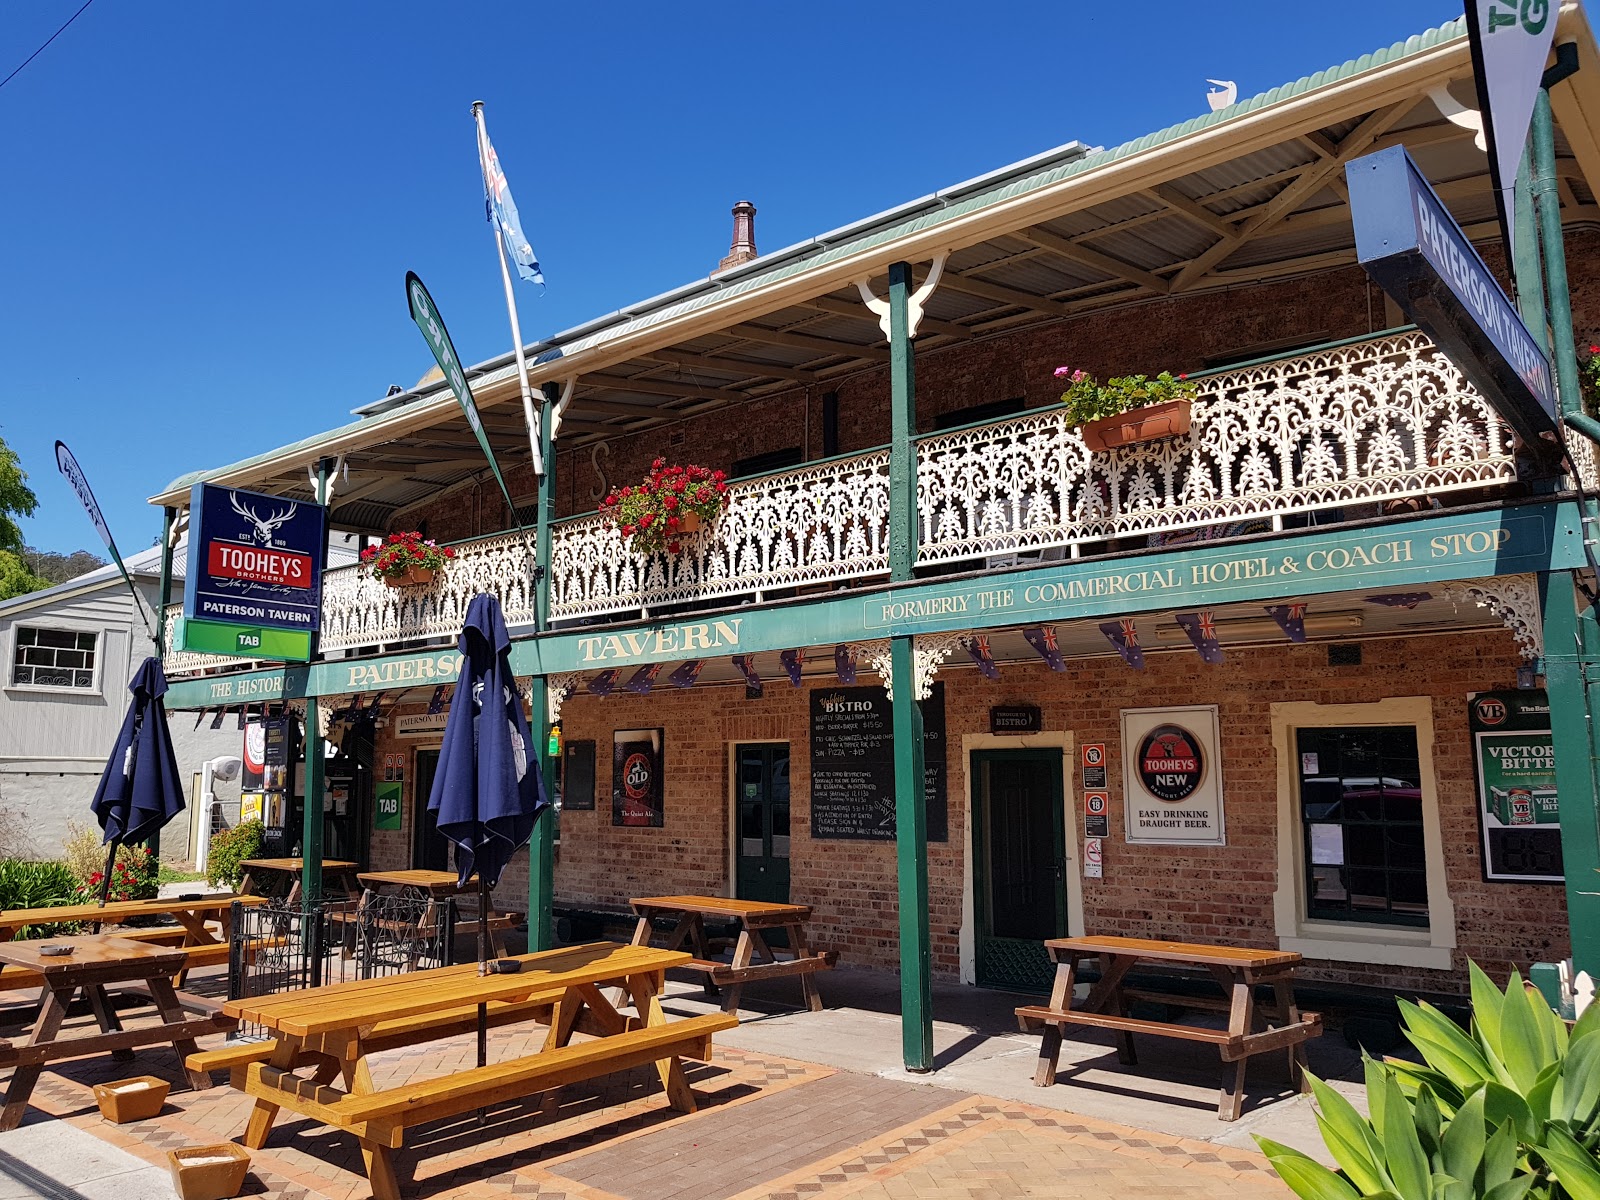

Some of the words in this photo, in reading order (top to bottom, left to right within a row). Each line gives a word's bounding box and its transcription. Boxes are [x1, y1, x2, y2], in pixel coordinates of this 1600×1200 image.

[1417, 191, 1504, 343] PATERSON
[1502, 309, 1548, 400] TAVERN
[220, 548, 302, 578] TOOHEYS
[237, 571, 284, 582] BROTHERS
[882, 593, 973, 621] FORMERLY
[977, 589, 1014, 609] THE
[1024, 568, 1181, 603] COMMERCIAL
[1191, 557, 1276, 585] HOTEL
[1279, 556, 1302, 575] &
[1306, 540, 1414, 571] COACH
[1430, 528, 1511, 558] STOP
[204, 602, 264, 617] PATERSON
[268, 609, 310, 623] TAVERN
[239, 635, 259, 646] TAB
[211, 683, 231, 698] THE
[237, 675, 294, 696] HISTORIC
[578, 618, 742, 662] TAVERN
[826, 701, 872, 712] BISTRO
[1478, 705, 1503, 718] VB
[400, 716, 432, 726] PATERSON
[1146, 760, 1194, 770] TOOHEYS
[627, 771, 648, 785] OLD
[1156, 774, 1187, 786] NEW
[1151, 785, 1177, 798] DRAUGHT
[1180, 785, 1193, 796] BEER
[380, 799, 397, 813] TAB
[1092, 802, 1100, 810] 18
[1514, 804, 1529, 812] VB
[1139, 810, 1160, 818] EASY
